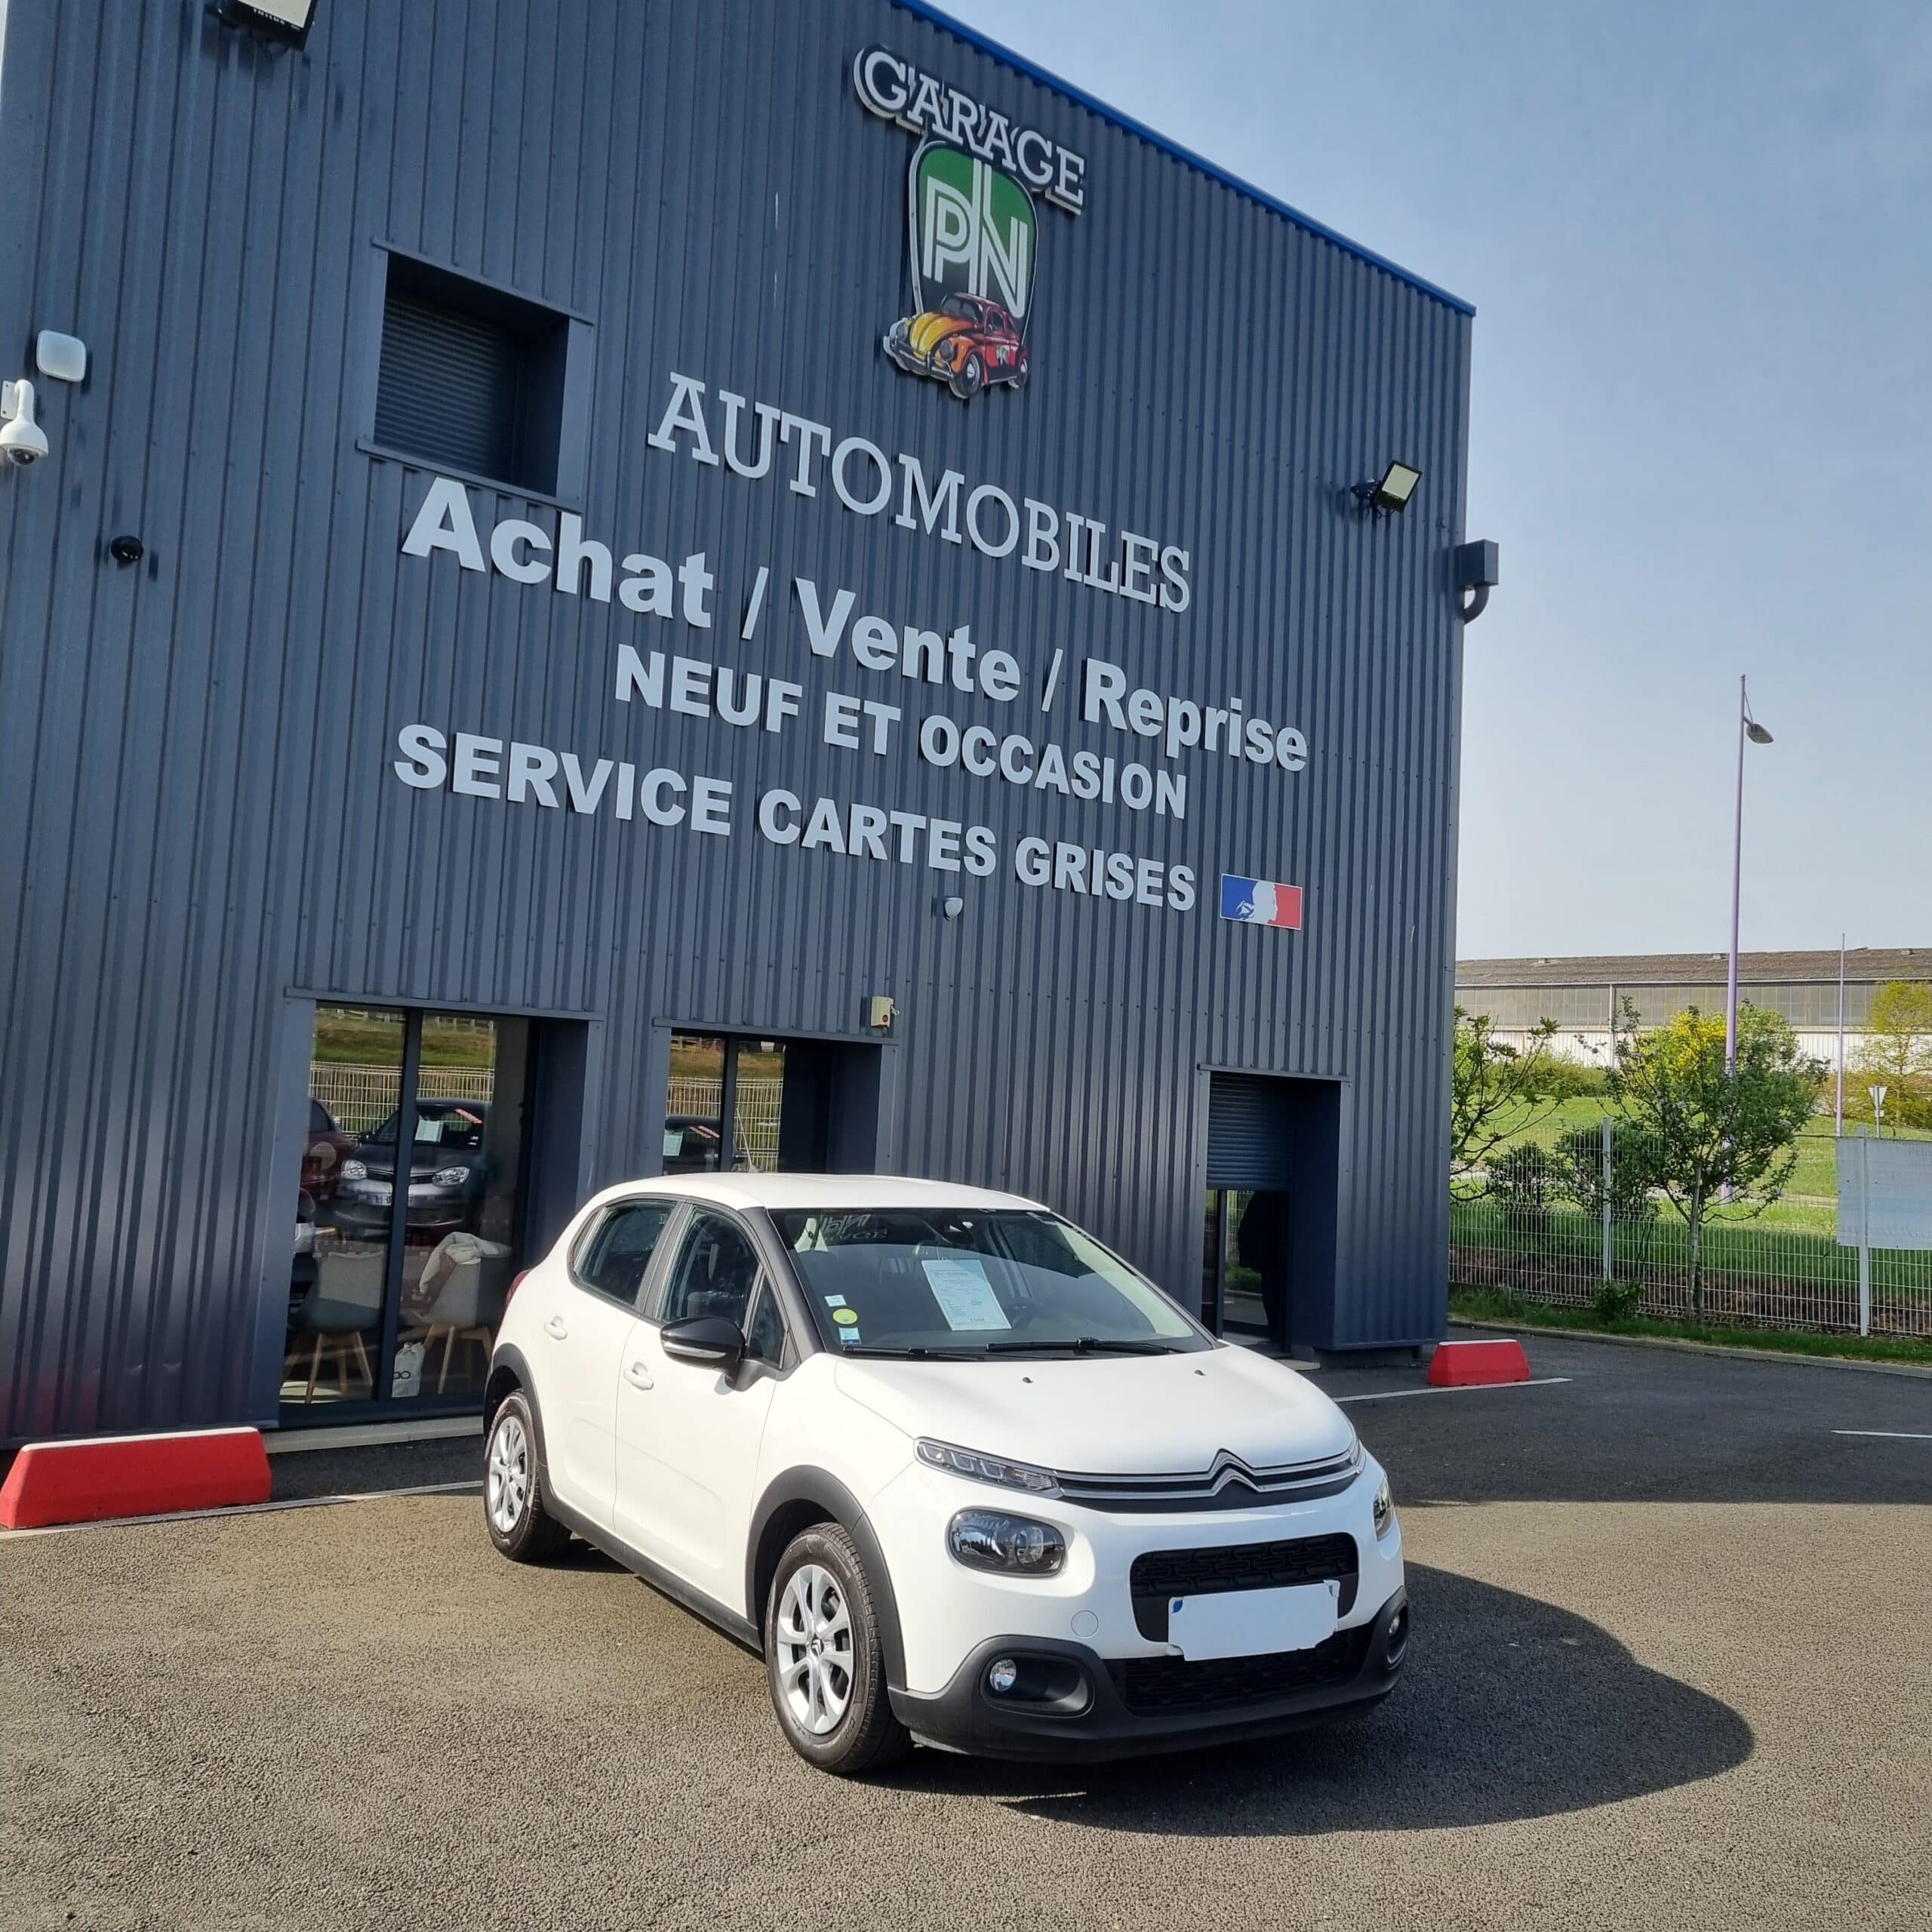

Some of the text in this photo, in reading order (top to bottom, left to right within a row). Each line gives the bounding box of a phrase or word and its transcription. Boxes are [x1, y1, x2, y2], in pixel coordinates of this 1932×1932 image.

[862, 49, 1085, 207] GARAGE
[648, 371, 1190, 613] AUTOMOBILES
[401, 476, 1308, 772] Achat / Vente / Reprise
[393, 724, 1195, 911] SERVICE CARTES GRISES
[615, 643, 1186, 820] NEUF ET OCCASION
